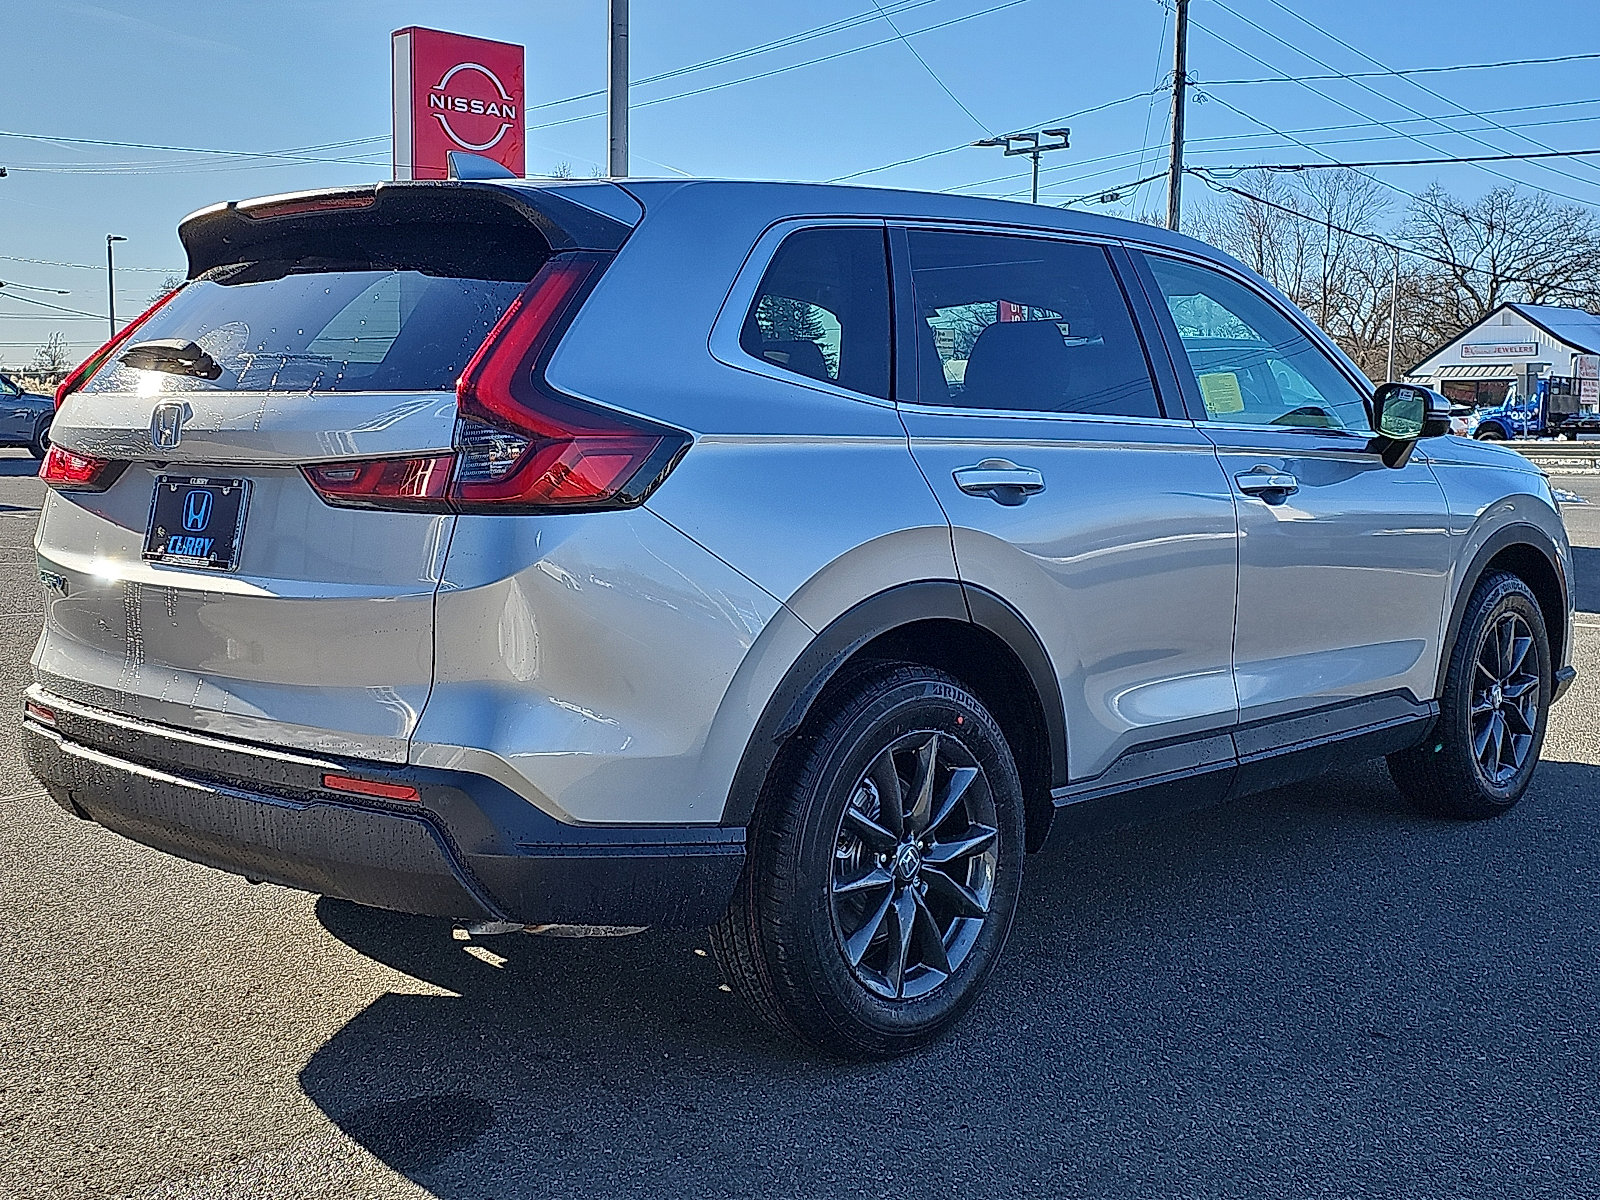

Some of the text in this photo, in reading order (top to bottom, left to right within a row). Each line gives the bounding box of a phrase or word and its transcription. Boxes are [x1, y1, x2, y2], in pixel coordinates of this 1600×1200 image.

[429, 93, 516, 119] NISSAN
[1493, 346, 1534, 354] JEWELERS
[1510, 411, 1532, 420] QXO
[167, 535, 214, 557] CURRY
